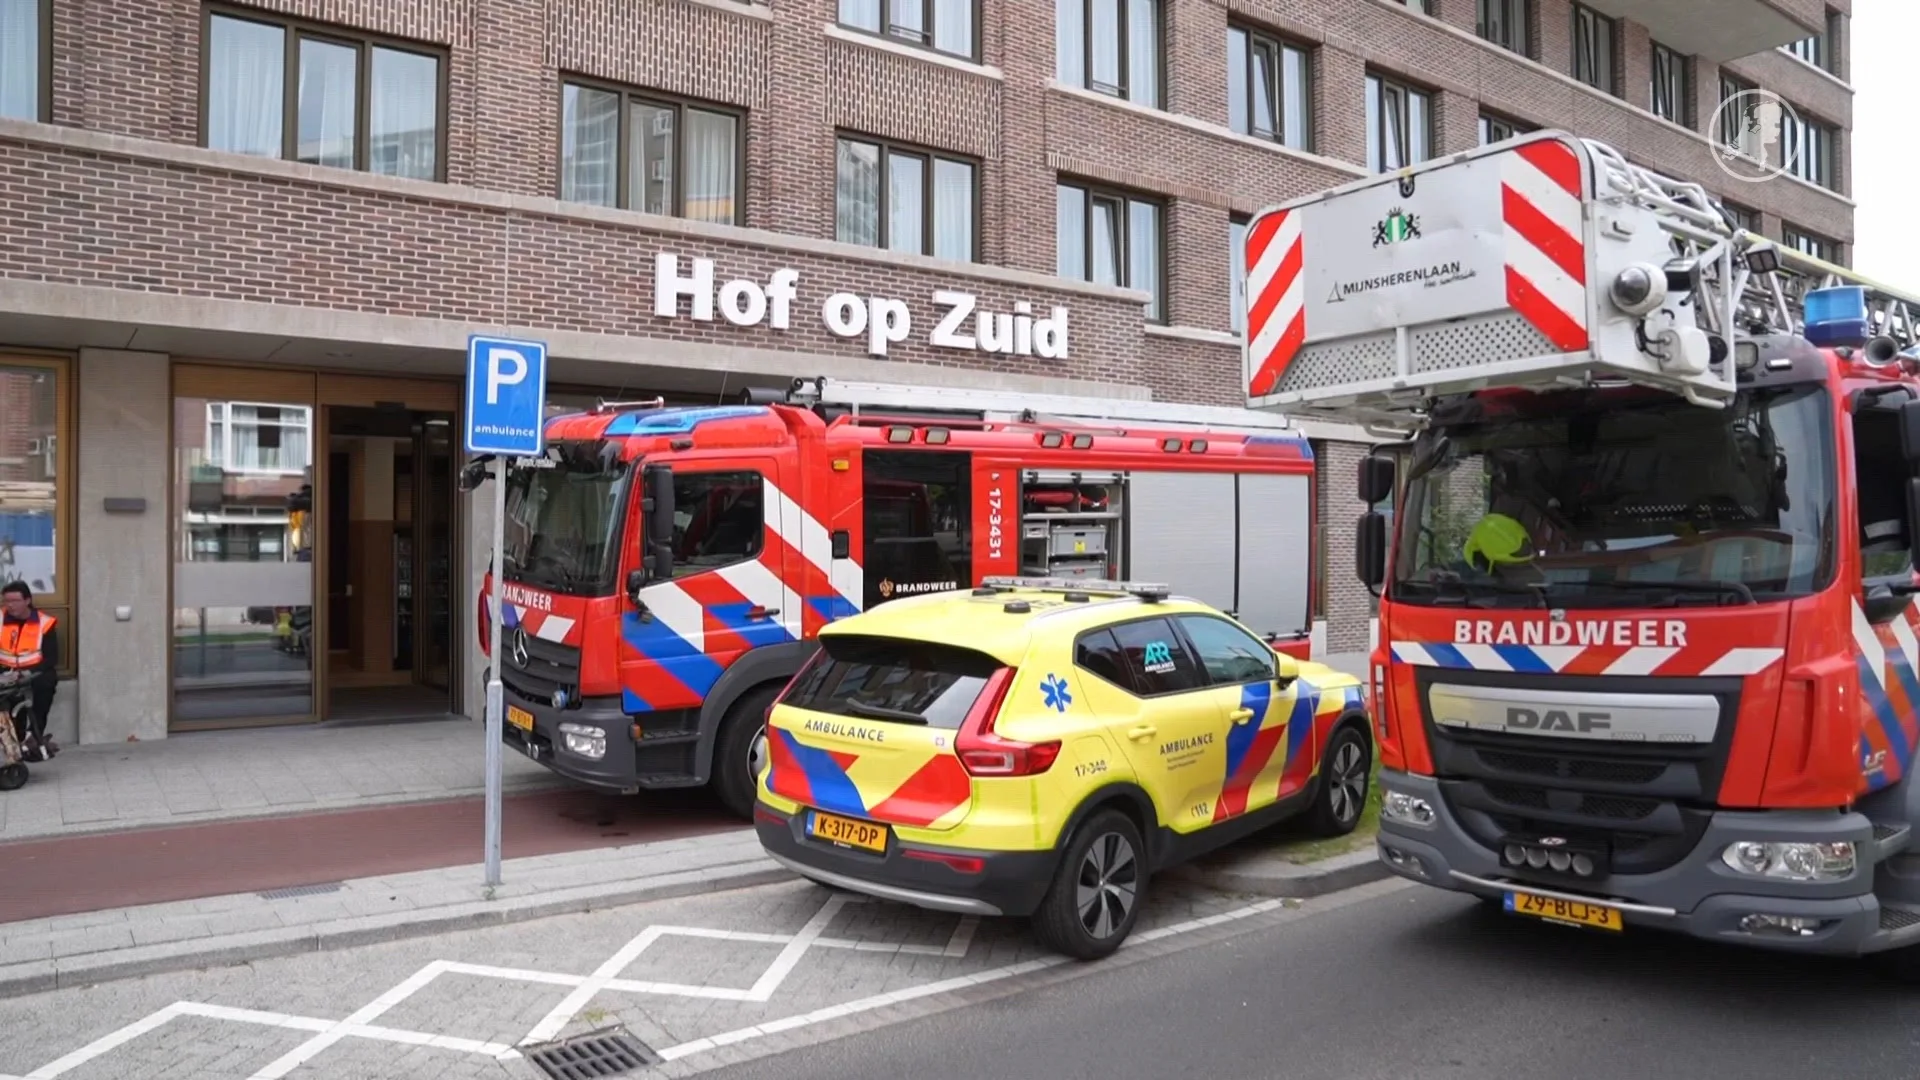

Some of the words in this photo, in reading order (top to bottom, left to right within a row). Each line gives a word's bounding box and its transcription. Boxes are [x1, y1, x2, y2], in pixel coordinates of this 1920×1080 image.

[1343, 261, 1461, 295] MIJNSHERENLAAN
[654, 253, 799, 329] Hof
[823, 292, 911, 355] op
[930, 291, 1068, 359] Zuid
[487, 347, 528, 404] P
[475, 425, 536, 437] ambulance
[989, 488, 1002, 558] 17-3431
[502, 583, 552, 612] RANDWEER
[896, 581, 957, 593] BRANDWEER
[1454, 619, 1688, 647] BRANDWEER
[1144, 641, 1172, 665] ARR
[804, 719, 885, 742] AMBULANCE
[1506, 707, 1612, 732] DAF
[1160, 733, 1214, 755] AMBULANCE
[819, 817, 878, 845] K-317-DP
[1523, 894, 1609, 924] 29-BLJ-3
